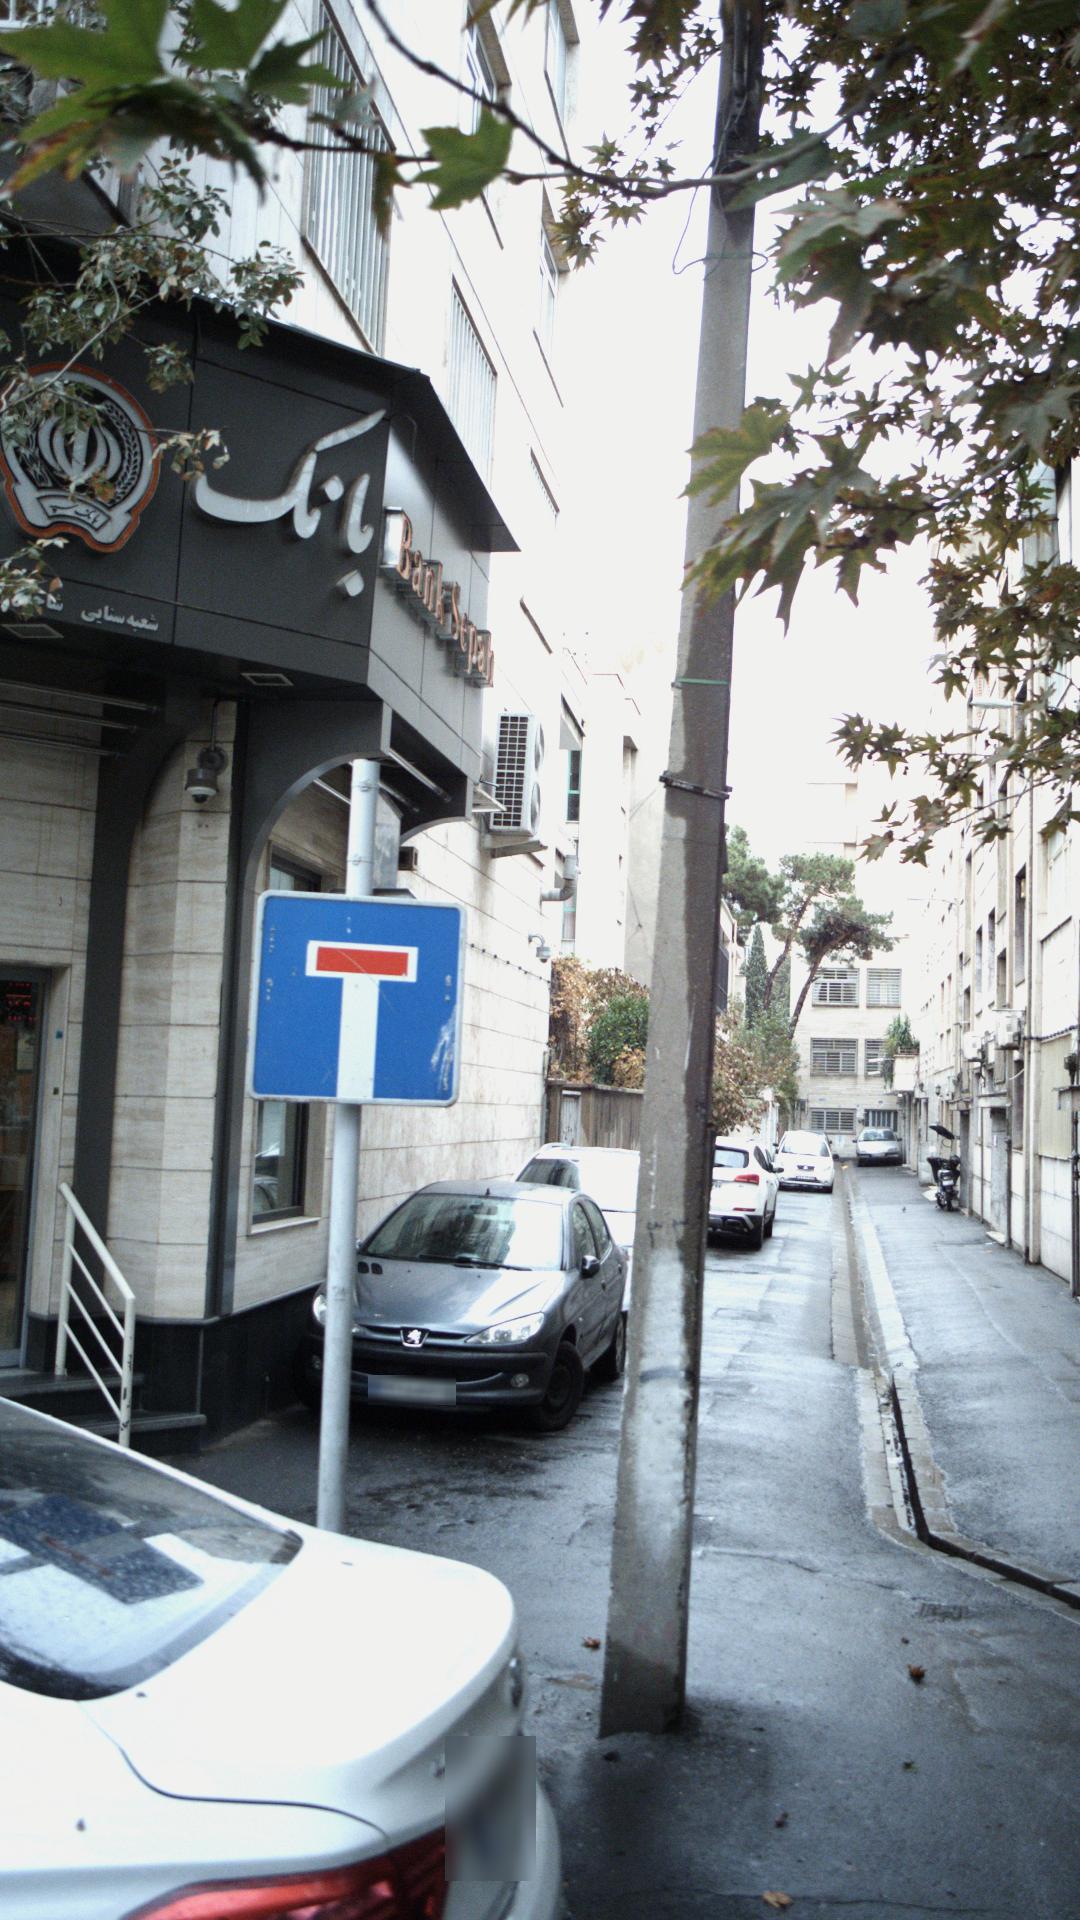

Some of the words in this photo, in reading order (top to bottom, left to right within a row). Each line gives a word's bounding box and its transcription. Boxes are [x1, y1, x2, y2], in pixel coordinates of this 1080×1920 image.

[194, 409, 386, 597] بانک
[126, 613, 159, 632] شعبه
[383, 507, 444, 625] Bank
